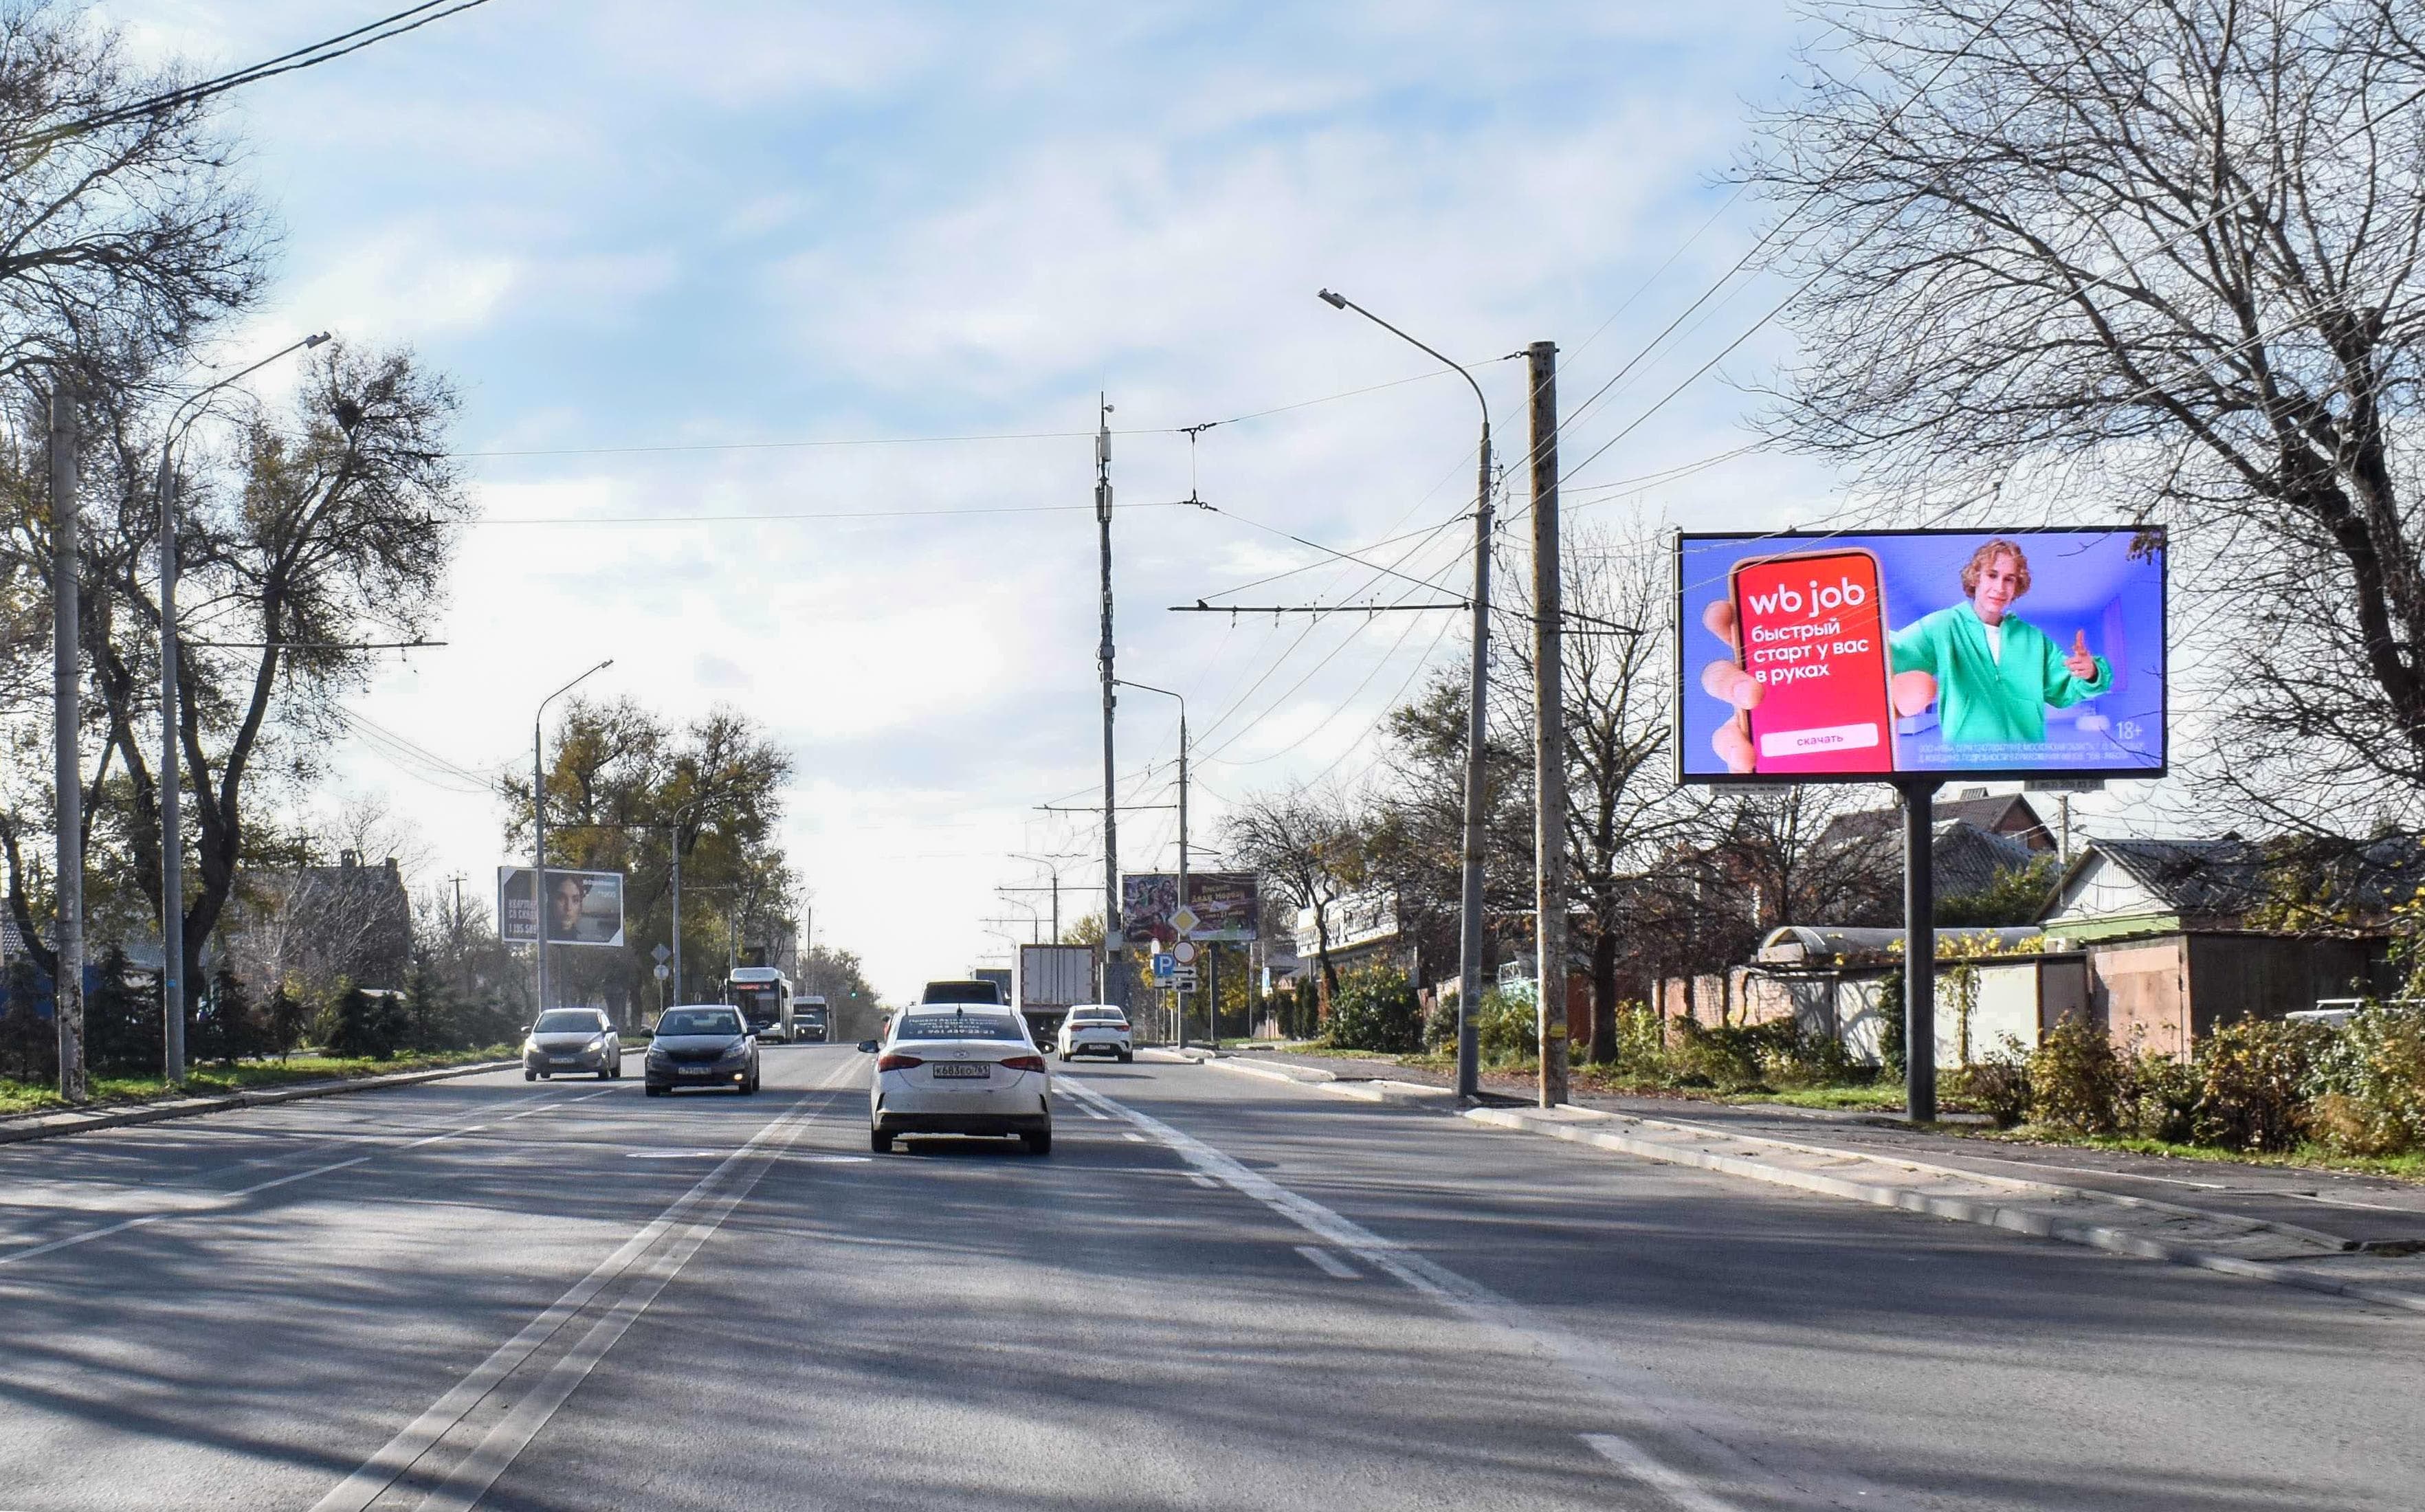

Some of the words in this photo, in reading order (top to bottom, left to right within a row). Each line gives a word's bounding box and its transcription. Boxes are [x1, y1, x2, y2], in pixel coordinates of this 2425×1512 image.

[1748, 583, 1802, 616] wb
[1808, 577, 1866, 618] job
[1751, 617, 1841, 643] быстрый
[1753, 645, 1813, 663] старт
[1816, 643, 1828, 660] у
[1832, 639, 1869, 655] вас
[1755, 669, 1767, 683] в
[1771, 663, 1830, 686] руках
[1797, 735, 1843, 746] скачать
[2116, 720, 2142, 740] 18+
